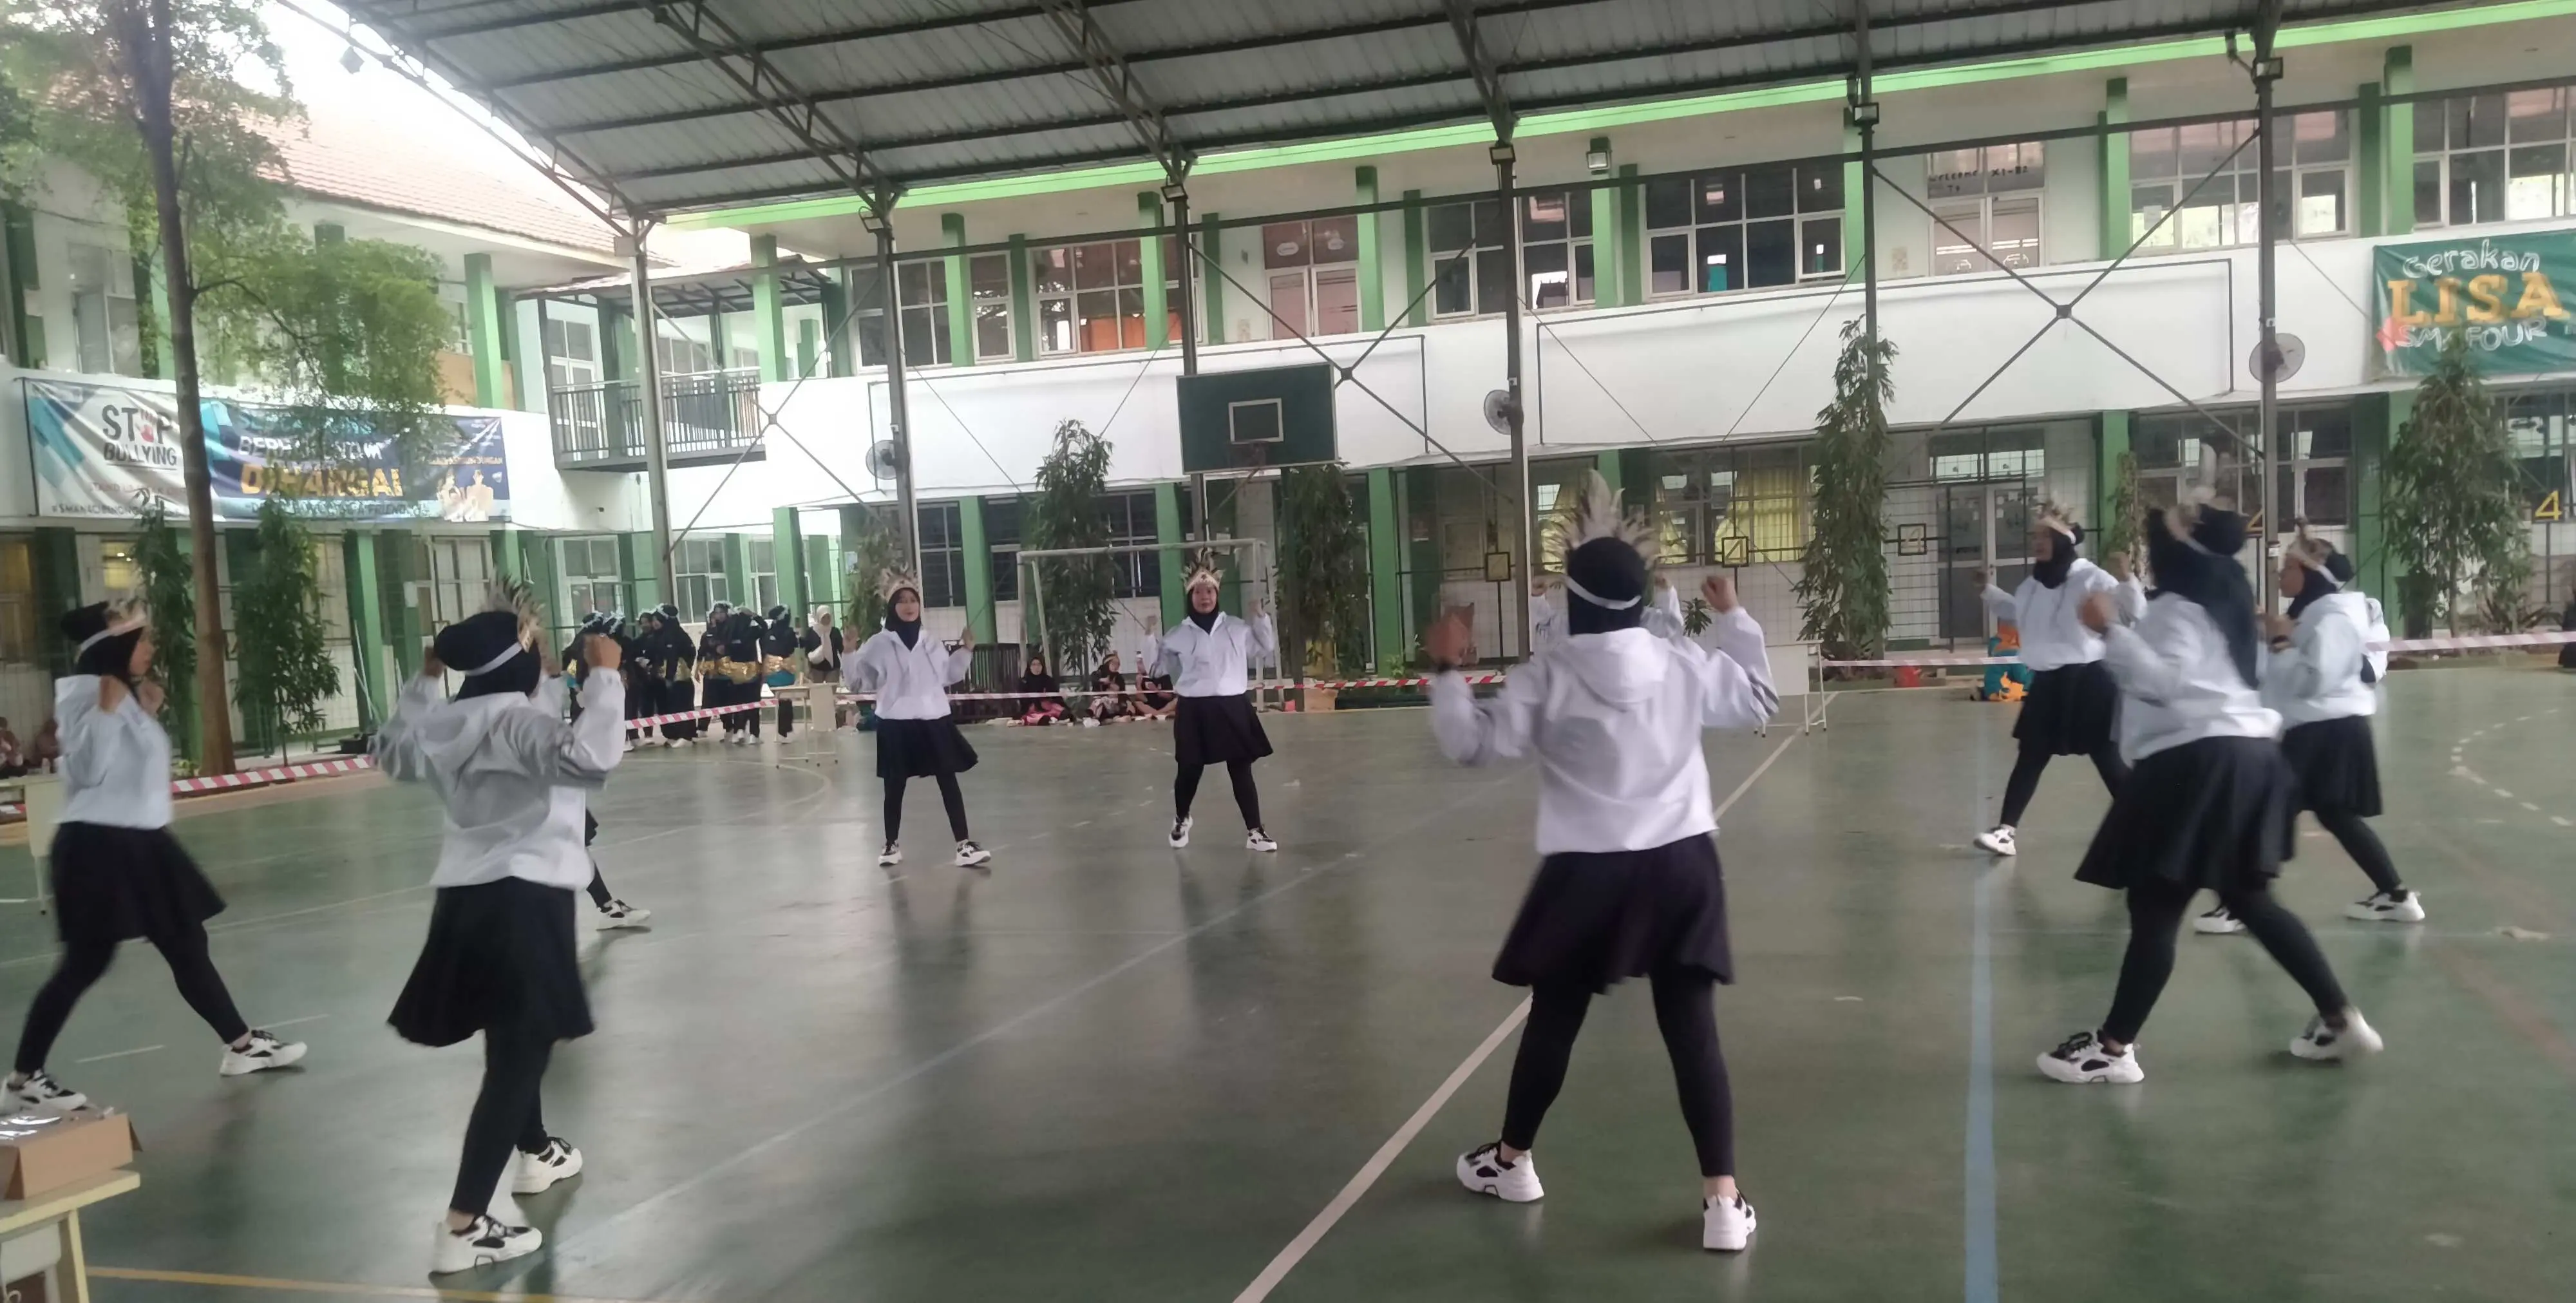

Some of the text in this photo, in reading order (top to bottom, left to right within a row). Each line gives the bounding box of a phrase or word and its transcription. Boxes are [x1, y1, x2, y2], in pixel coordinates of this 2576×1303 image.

[2403, 238, 2541, 278] Gerakan
[2387, 272, 2570, 327] LISA
[104, 442, 177, 466] BULLYING
[2535, 490, 2562, 521] 4
